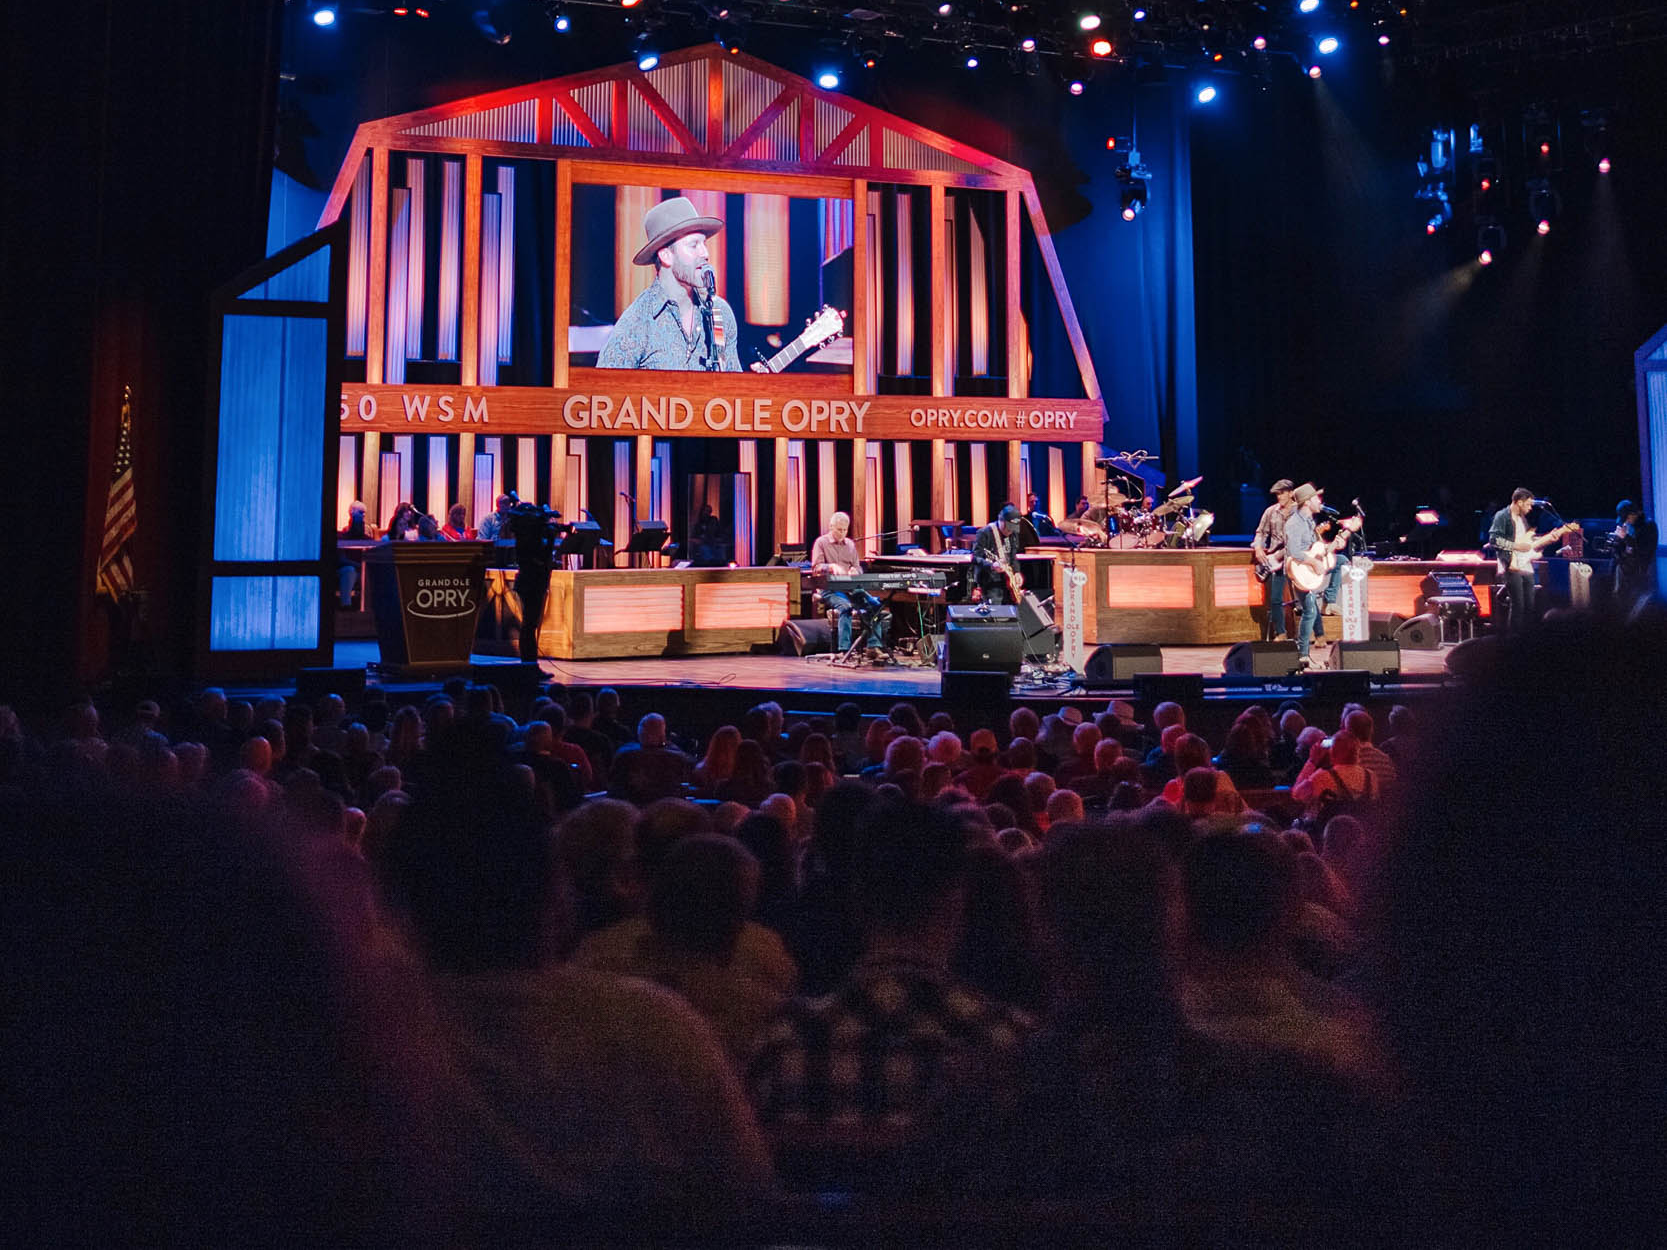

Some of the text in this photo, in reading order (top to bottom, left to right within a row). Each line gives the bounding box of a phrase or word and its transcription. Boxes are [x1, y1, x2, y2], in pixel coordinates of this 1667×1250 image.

[402, 395, 490, 423] WSM
[562, 394, 871, 433] GRAND OLE OPRY
[910, 408, 1008, 429] OPRY.COM
[417, 578, 470, 587] GRAND OLE
[416, 589, 470, 608] OPRY
